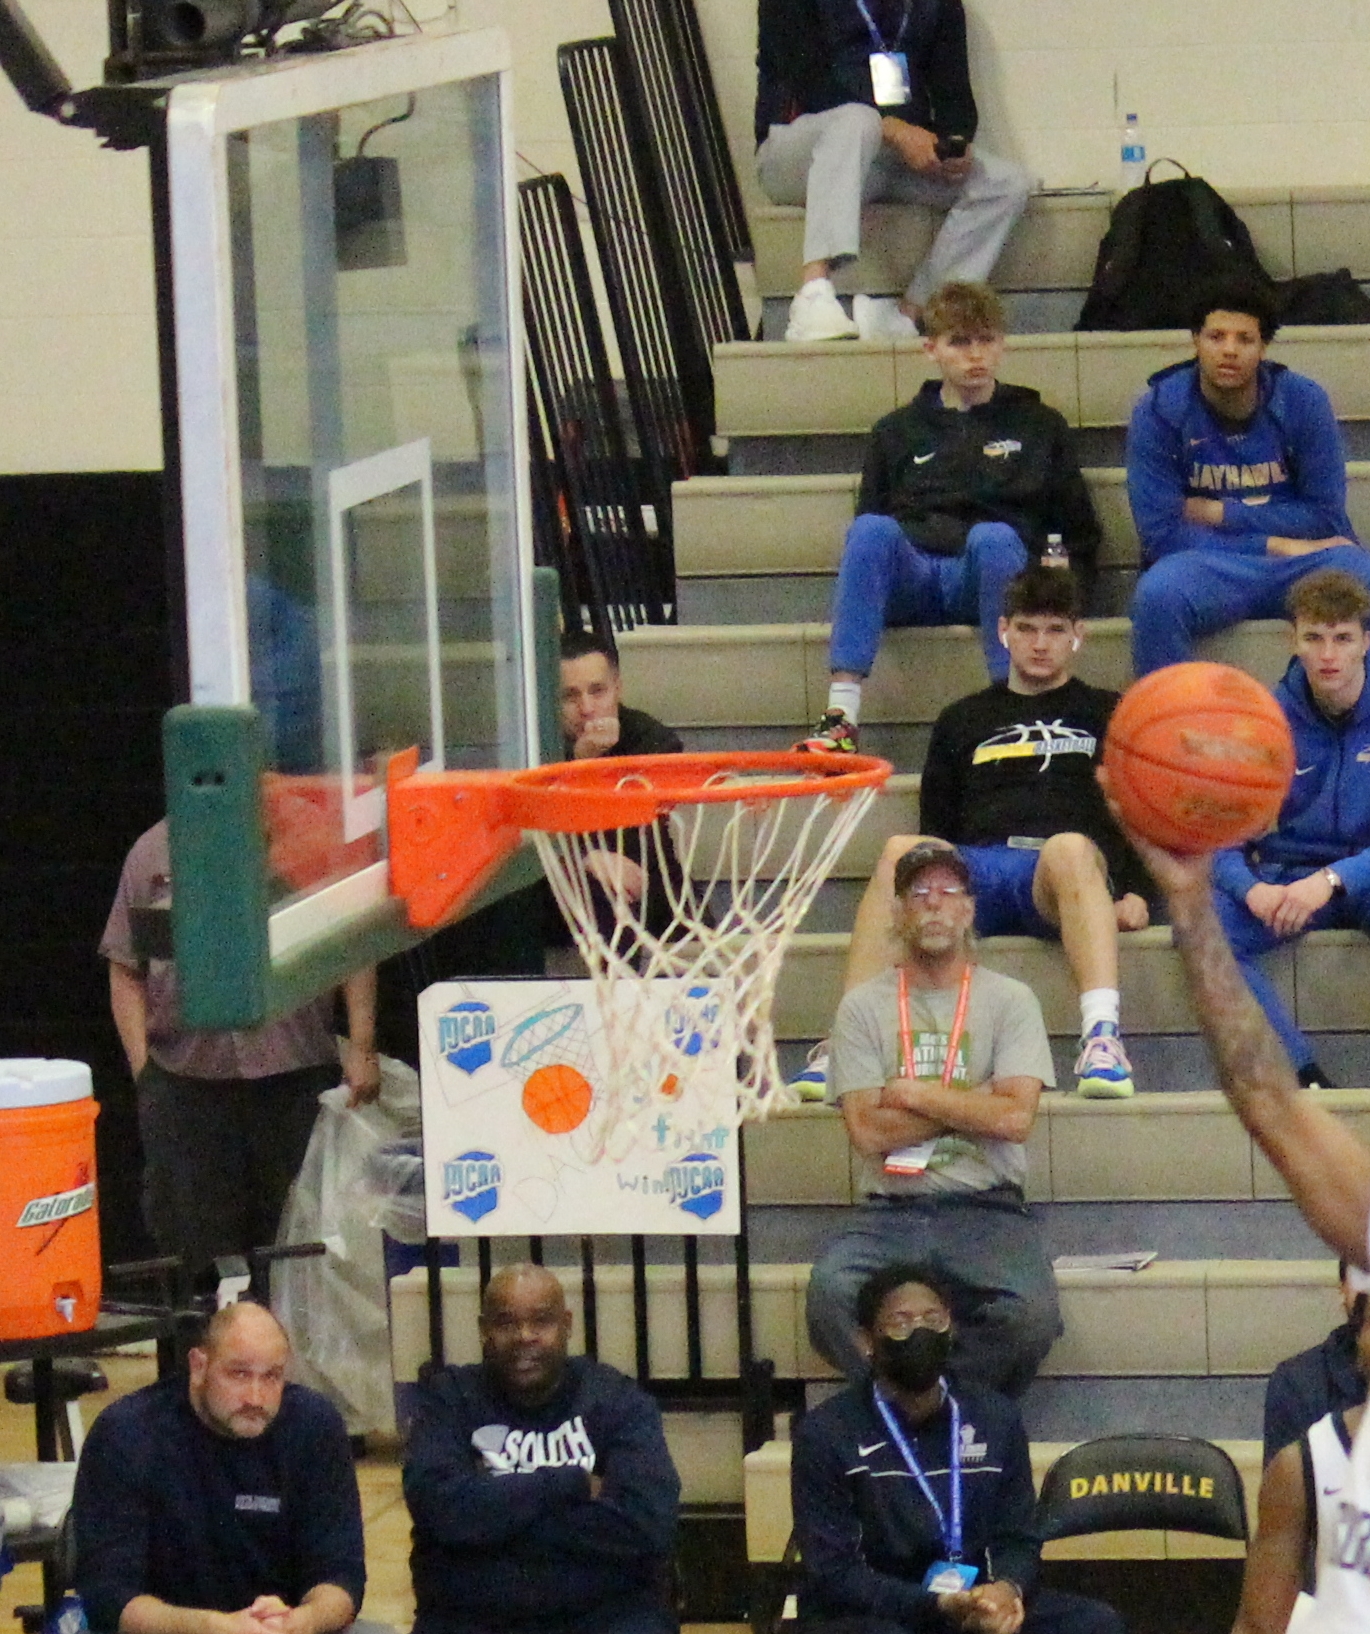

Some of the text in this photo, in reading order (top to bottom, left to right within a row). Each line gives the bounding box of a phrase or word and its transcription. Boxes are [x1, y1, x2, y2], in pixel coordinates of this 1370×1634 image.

[20, 1187, 93, 1224] Gator
[500, 1415, 596, 1468] SOUTH
[1070, 1472, 1215, 1499] DANVILLE
